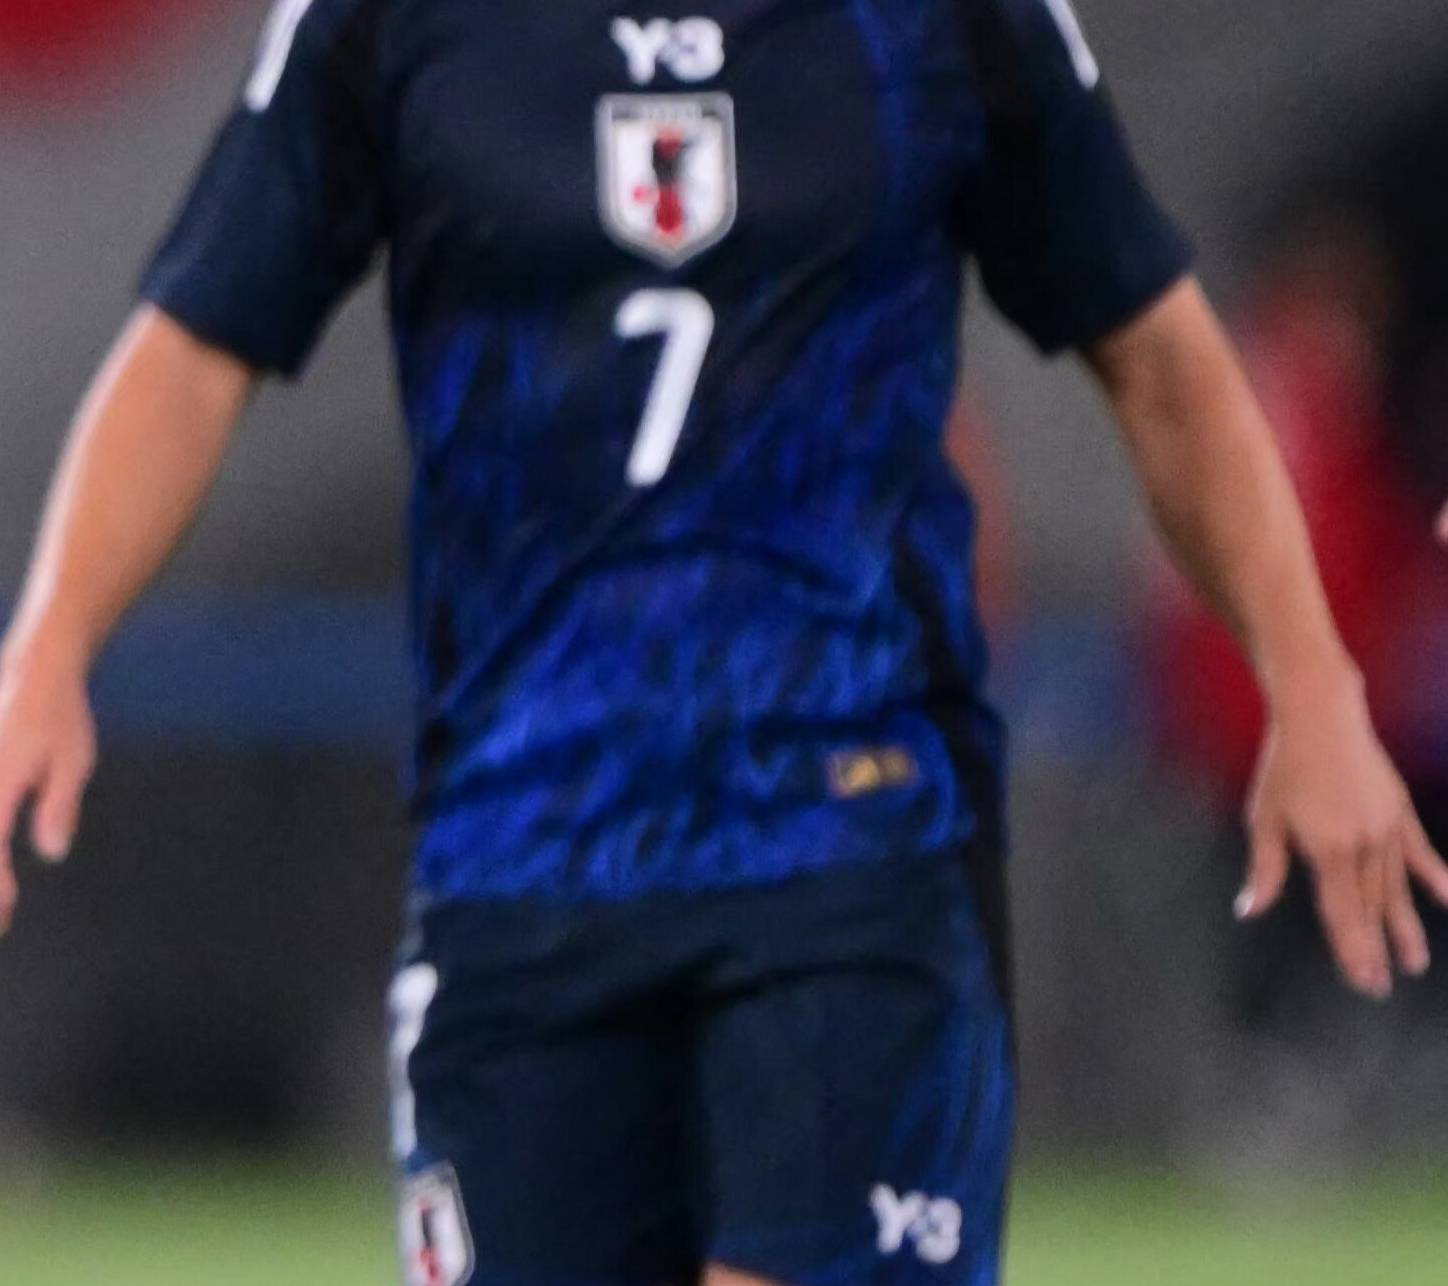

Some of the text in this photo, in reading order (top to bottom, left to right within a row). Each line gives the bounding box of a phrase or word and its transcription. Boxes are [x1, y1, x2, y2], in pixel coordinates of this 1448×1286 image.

[611, 16, 726, 85] Y-3
[613, 288, 715, 488] 7
[869, 1183, 964, 1265] Y-3
